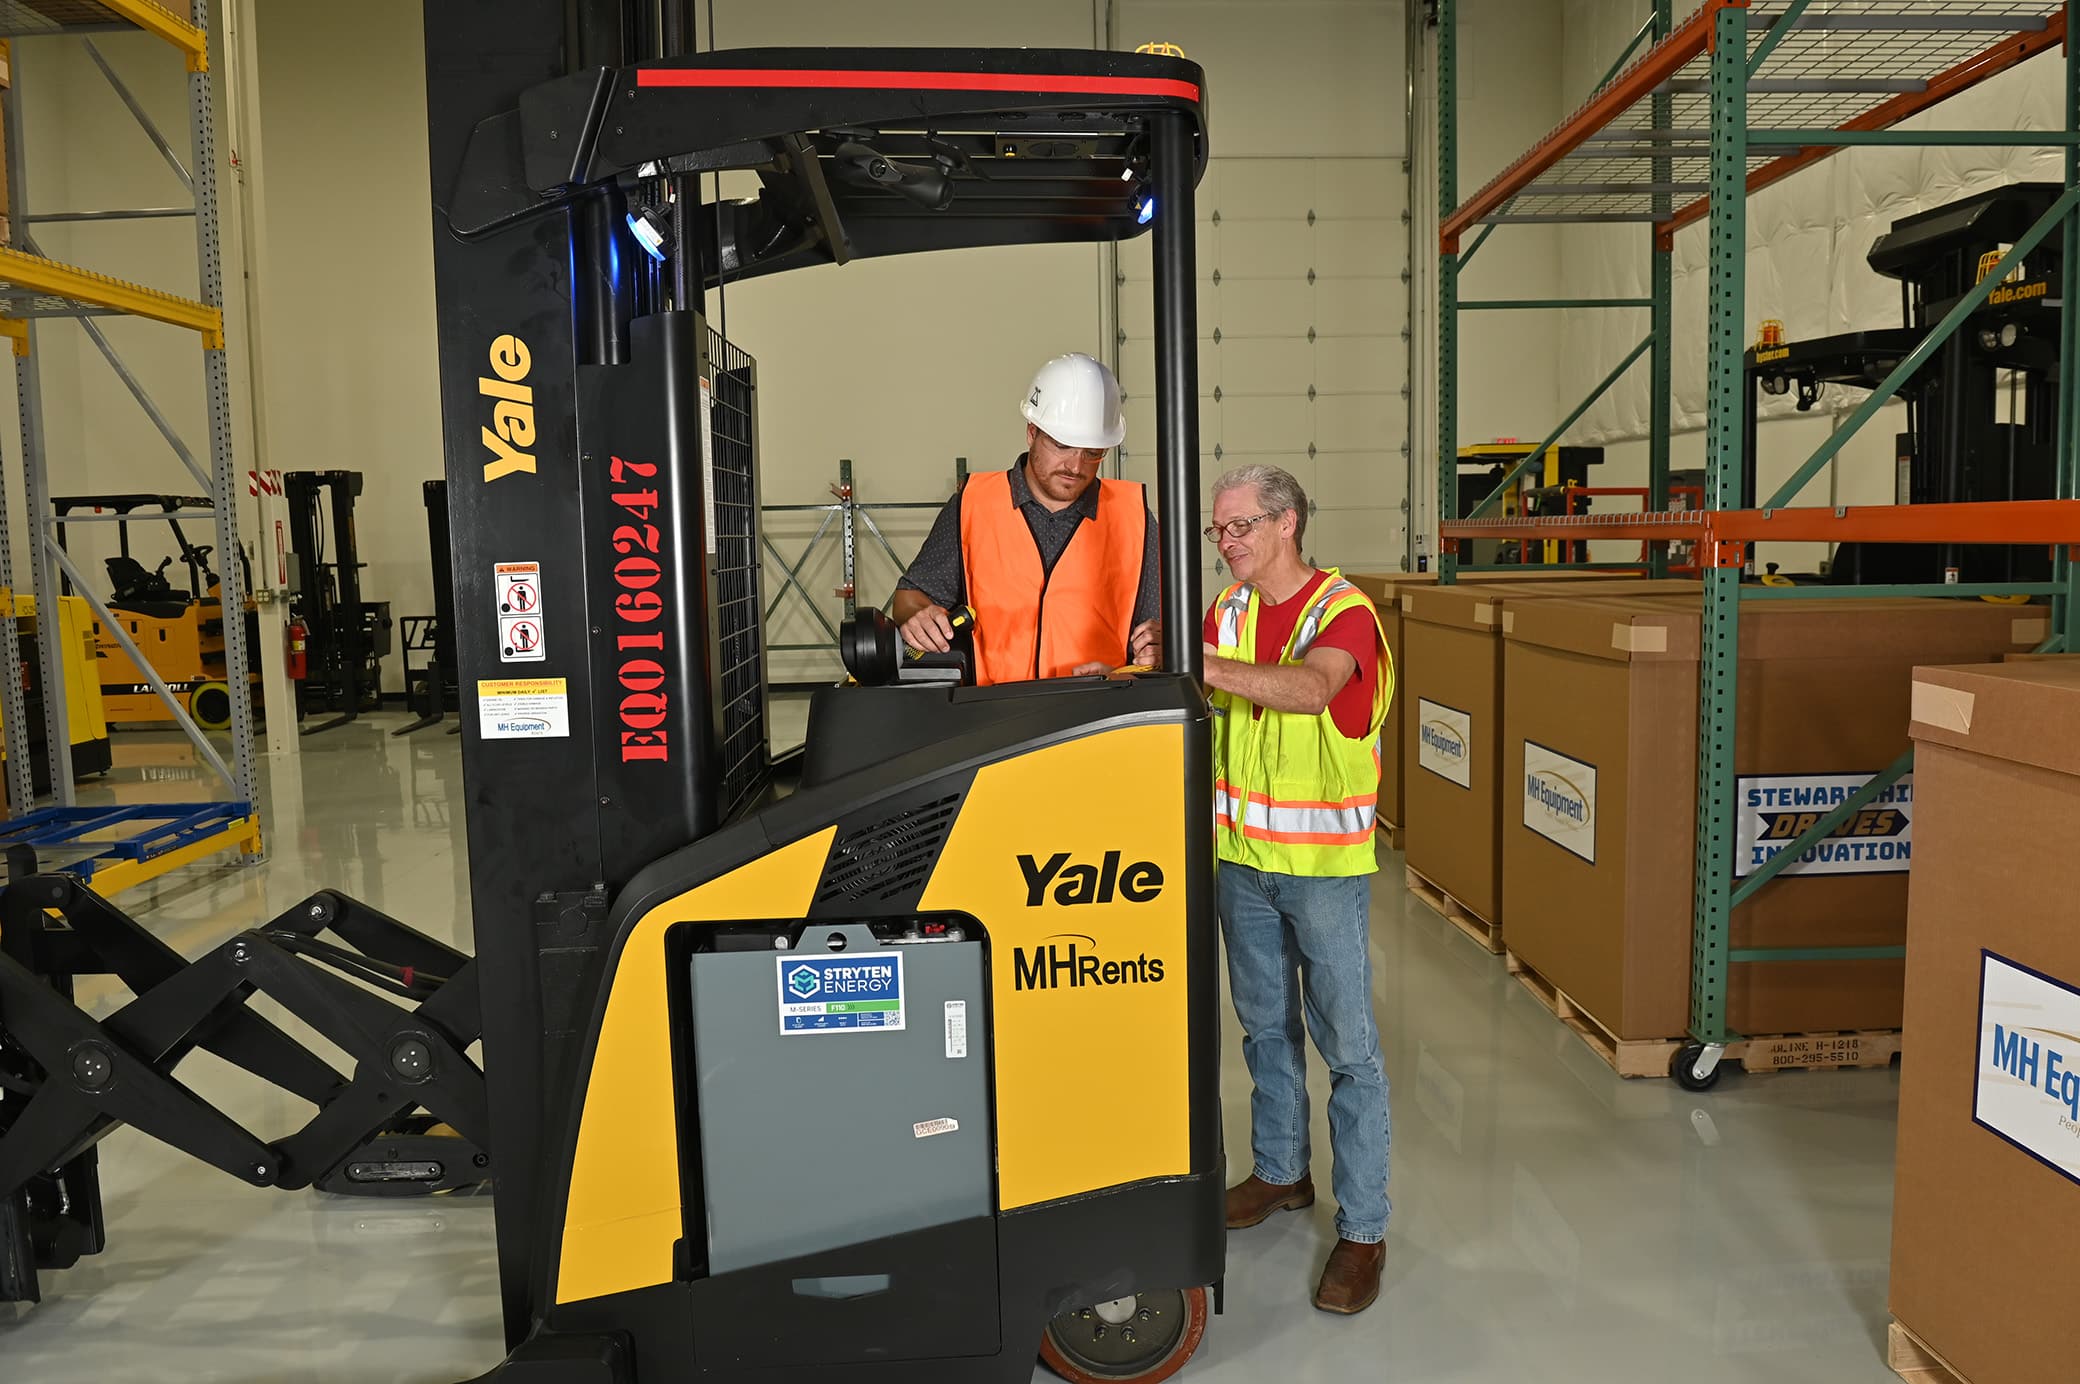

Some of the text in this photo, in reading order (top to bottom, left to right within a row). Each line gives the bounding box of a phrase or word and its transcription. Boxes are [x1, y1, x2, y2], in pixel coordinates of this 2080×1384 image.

[478, 334, 537, 483] Yale
[609, 455, 669, 764] EQ0160247
[498, 722, 545, 732] MH Equipment
[1421, 724, 1431, 743] MH
[1431, 728, 1462, 758] Equipment
[1527, 774, 1540, 800] MH
[1540, 780, 1583, 822] Equipment
[1016, 850, 1164, 907] Yale
[824, 965, 892, 980] STRYTEN
[824, 978, 892, 993] ENERGY
[790, 1005, 822, 1013] M-SERIES
[1816, 1039, 1859, 1051] H-1218
[1993, 1023, 2040, 1088] MH
[1773, 1052, 1859, 1065] 800-295-5510
